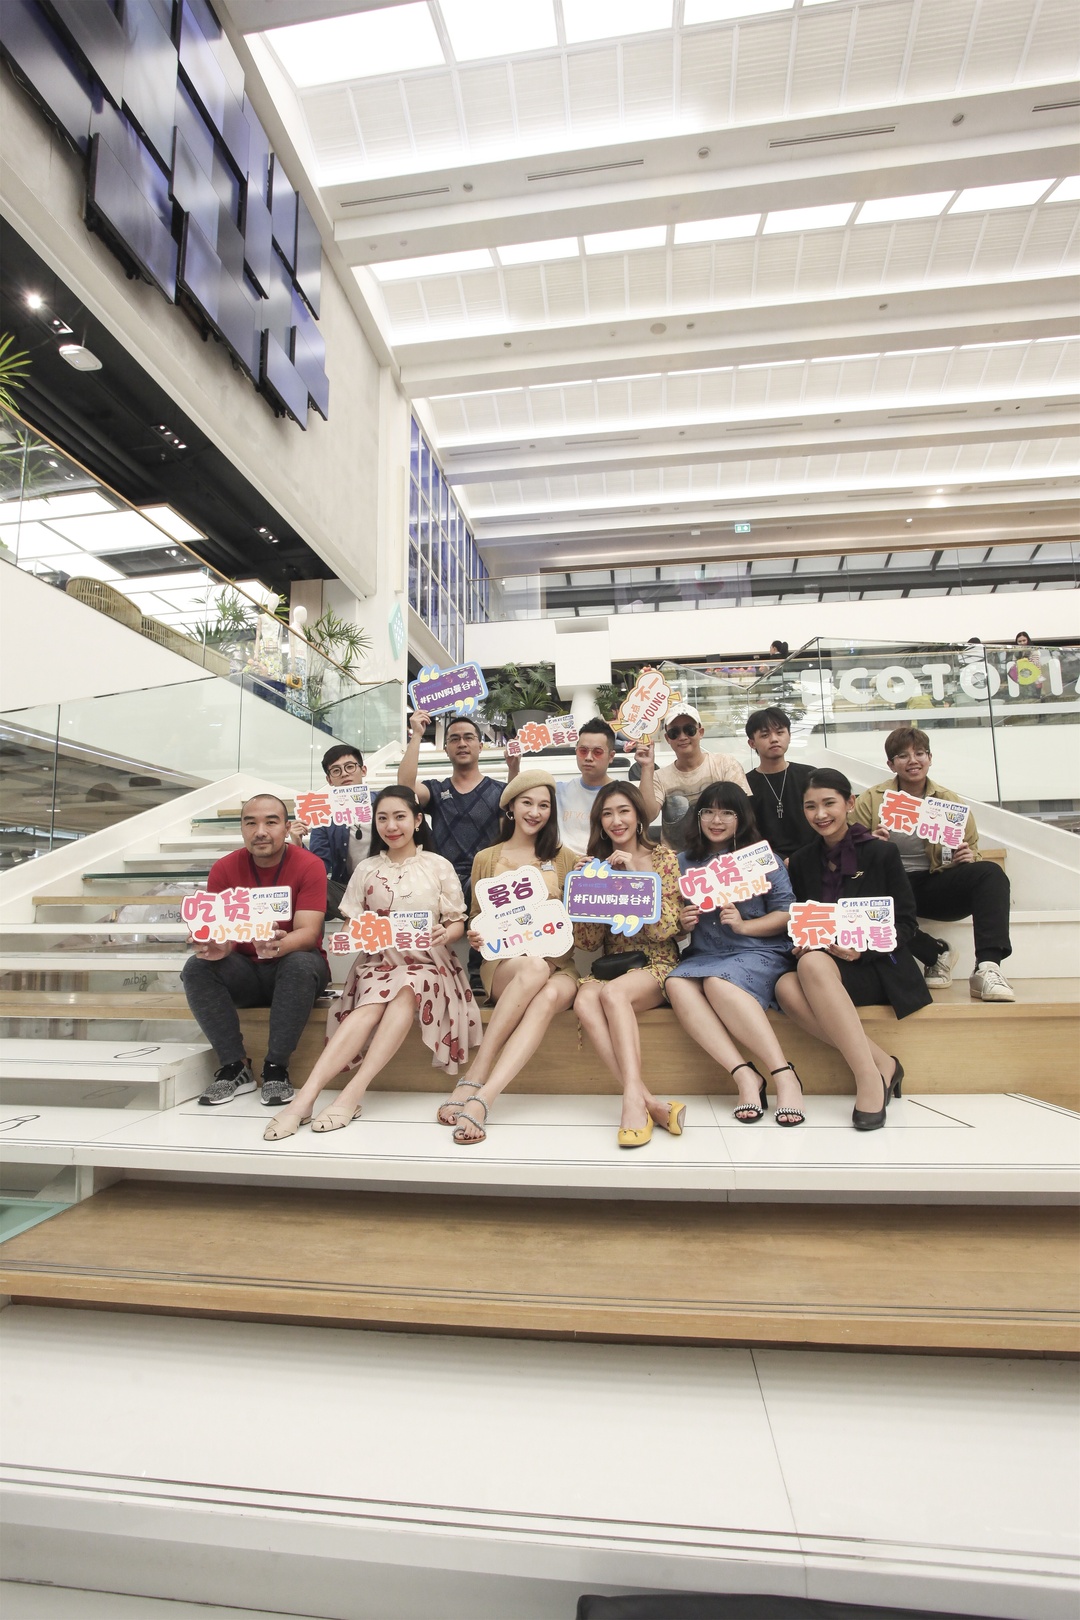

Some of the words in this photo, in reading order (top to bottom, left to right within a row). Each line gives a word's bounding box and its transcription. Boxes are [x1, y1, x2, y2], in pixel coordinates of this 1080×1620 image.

[801, 659, 1080, 706] ECOTOPI
[641, 692, 667, 722] YOUNG
[508, 723, 579, 756] 最潮曼谷
[488, 877, 534, 908] 曼谷
[679, 855, 743, 898] 吃货
[716, 875, 772, 907] 小分队
[184, 889, 251, 923] 吃货
[573, 894, 651, 906] #FUN购曼谷#
[213, 922, 275, 943] 小分队
[333, 914, 431, 952] 最潮曼谷
